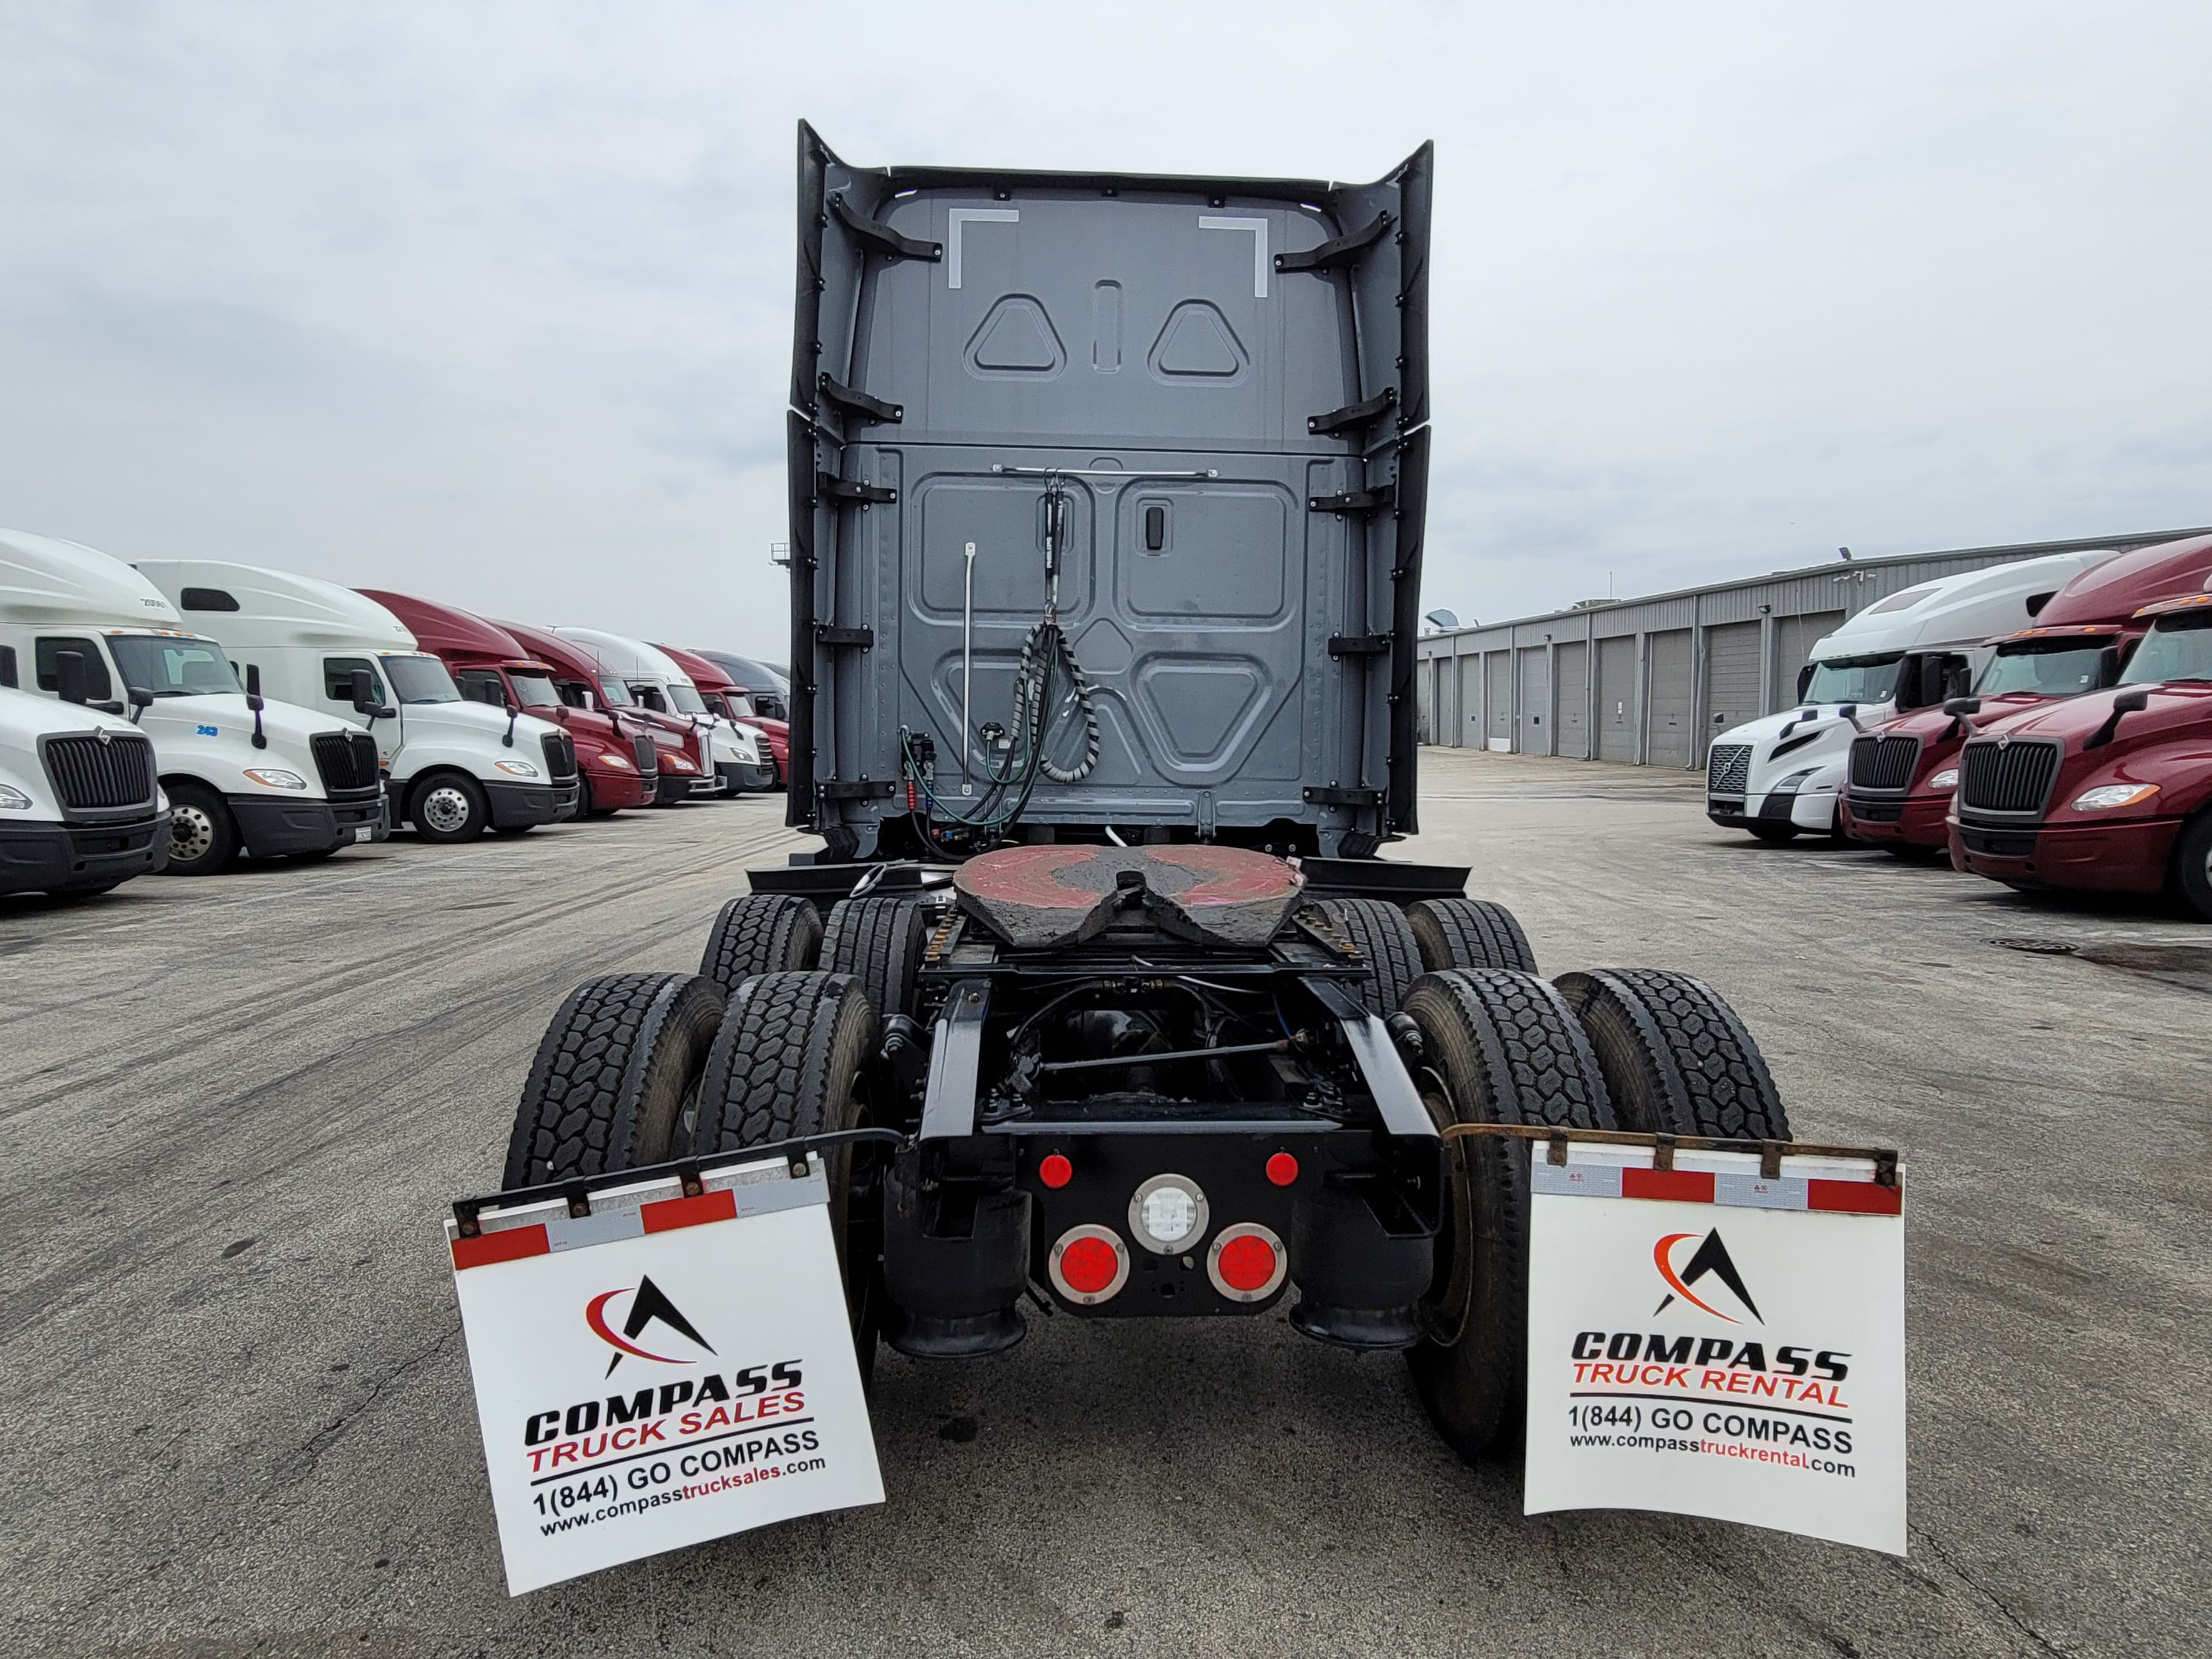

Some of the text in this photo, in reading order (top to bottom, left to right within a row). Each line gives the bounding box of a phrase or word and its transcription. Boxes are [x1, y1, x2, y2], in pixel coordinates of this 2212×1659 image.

[1571, 1331, 1853, 1382] COMPASS
[1573, 1363, 1849, 1408] TRUCK RENTAL
[524, 1359, 803, 1446] COMPASS
[526, 1391, 805, 1473] TRUCK SALES
[1569, 1405, 1853, 1454] 1(844) GO COMPASS
[533, 1430, 820, 1518] 1(844) GO COMPASS
[1570, 1435, 1855, 1478] www.compasstruckrental.com
[540, 1457, 826, 1537] www.compasstrucksales.com
